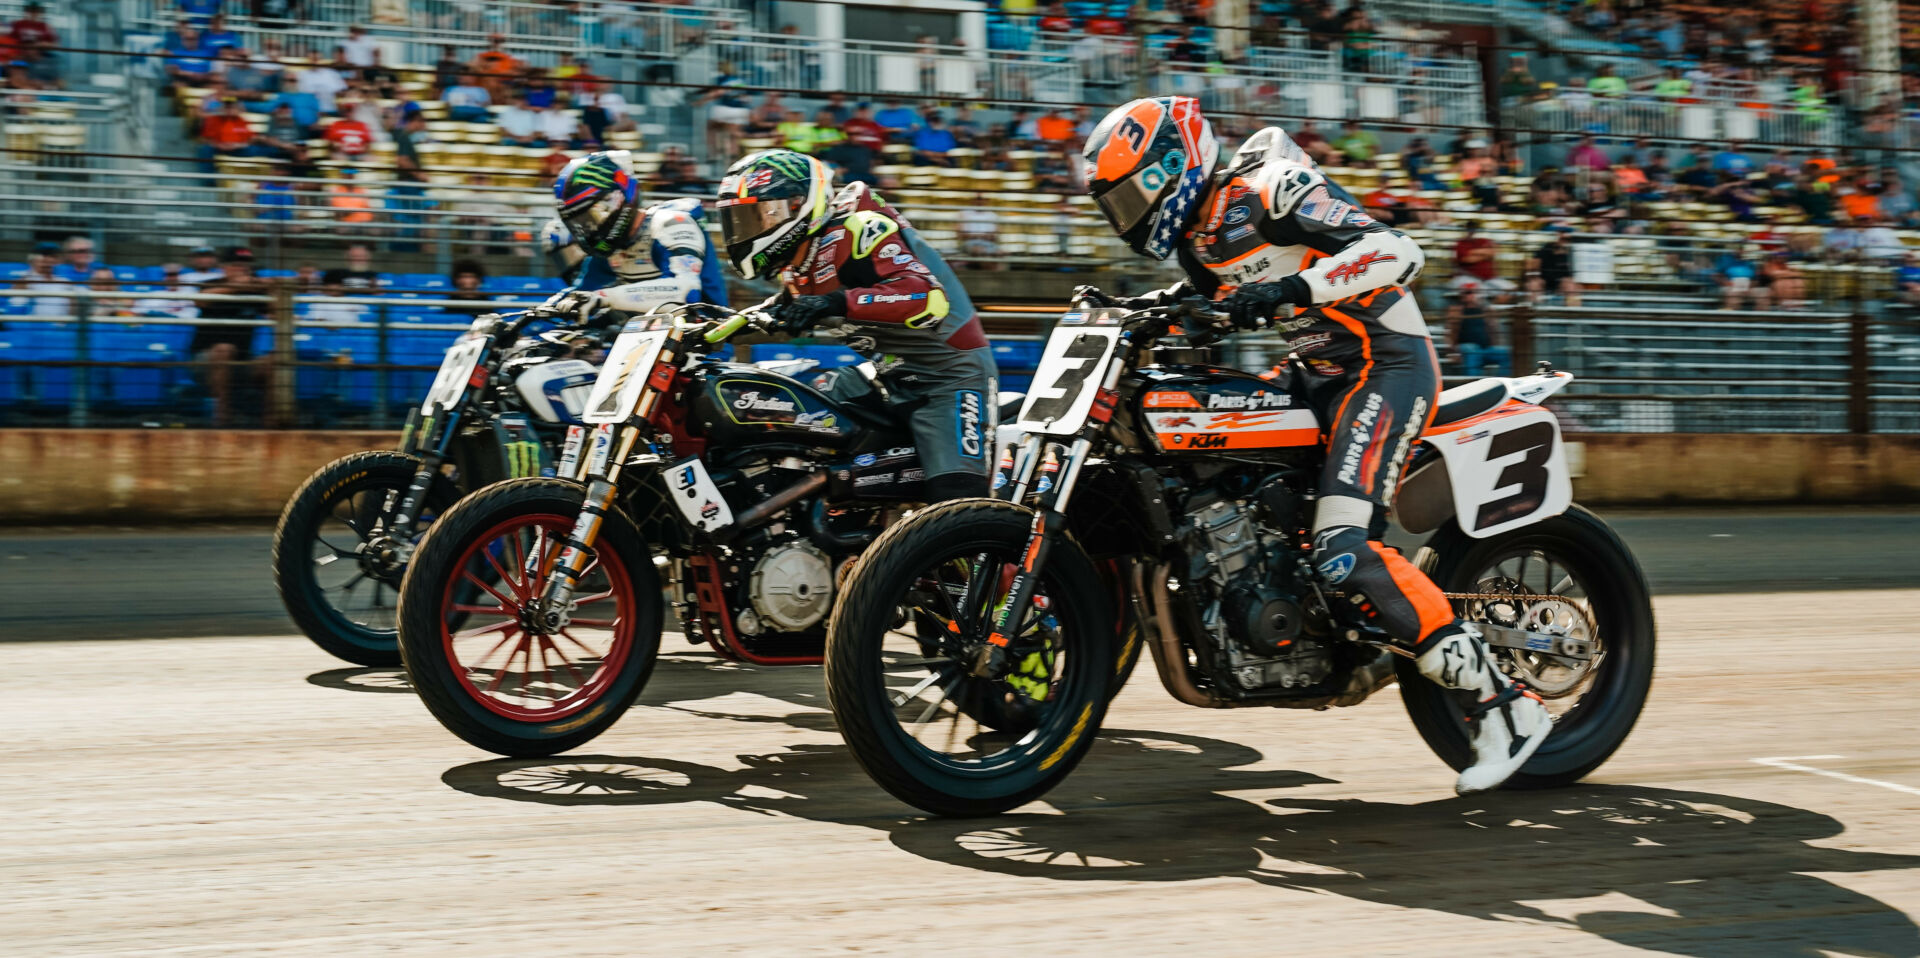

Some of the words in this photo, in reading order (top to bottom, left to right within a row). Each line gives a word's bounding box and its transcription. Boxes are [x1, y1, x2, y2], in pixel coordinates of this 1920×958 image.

[1118, 116, 1145, 153] 3
[1022, 334, 1109, 422] 3
[960, 392, 980, 455] Corbin
[1188, 432, 1229, 449] KTM
[1473, 421, 1555, 532] 3
